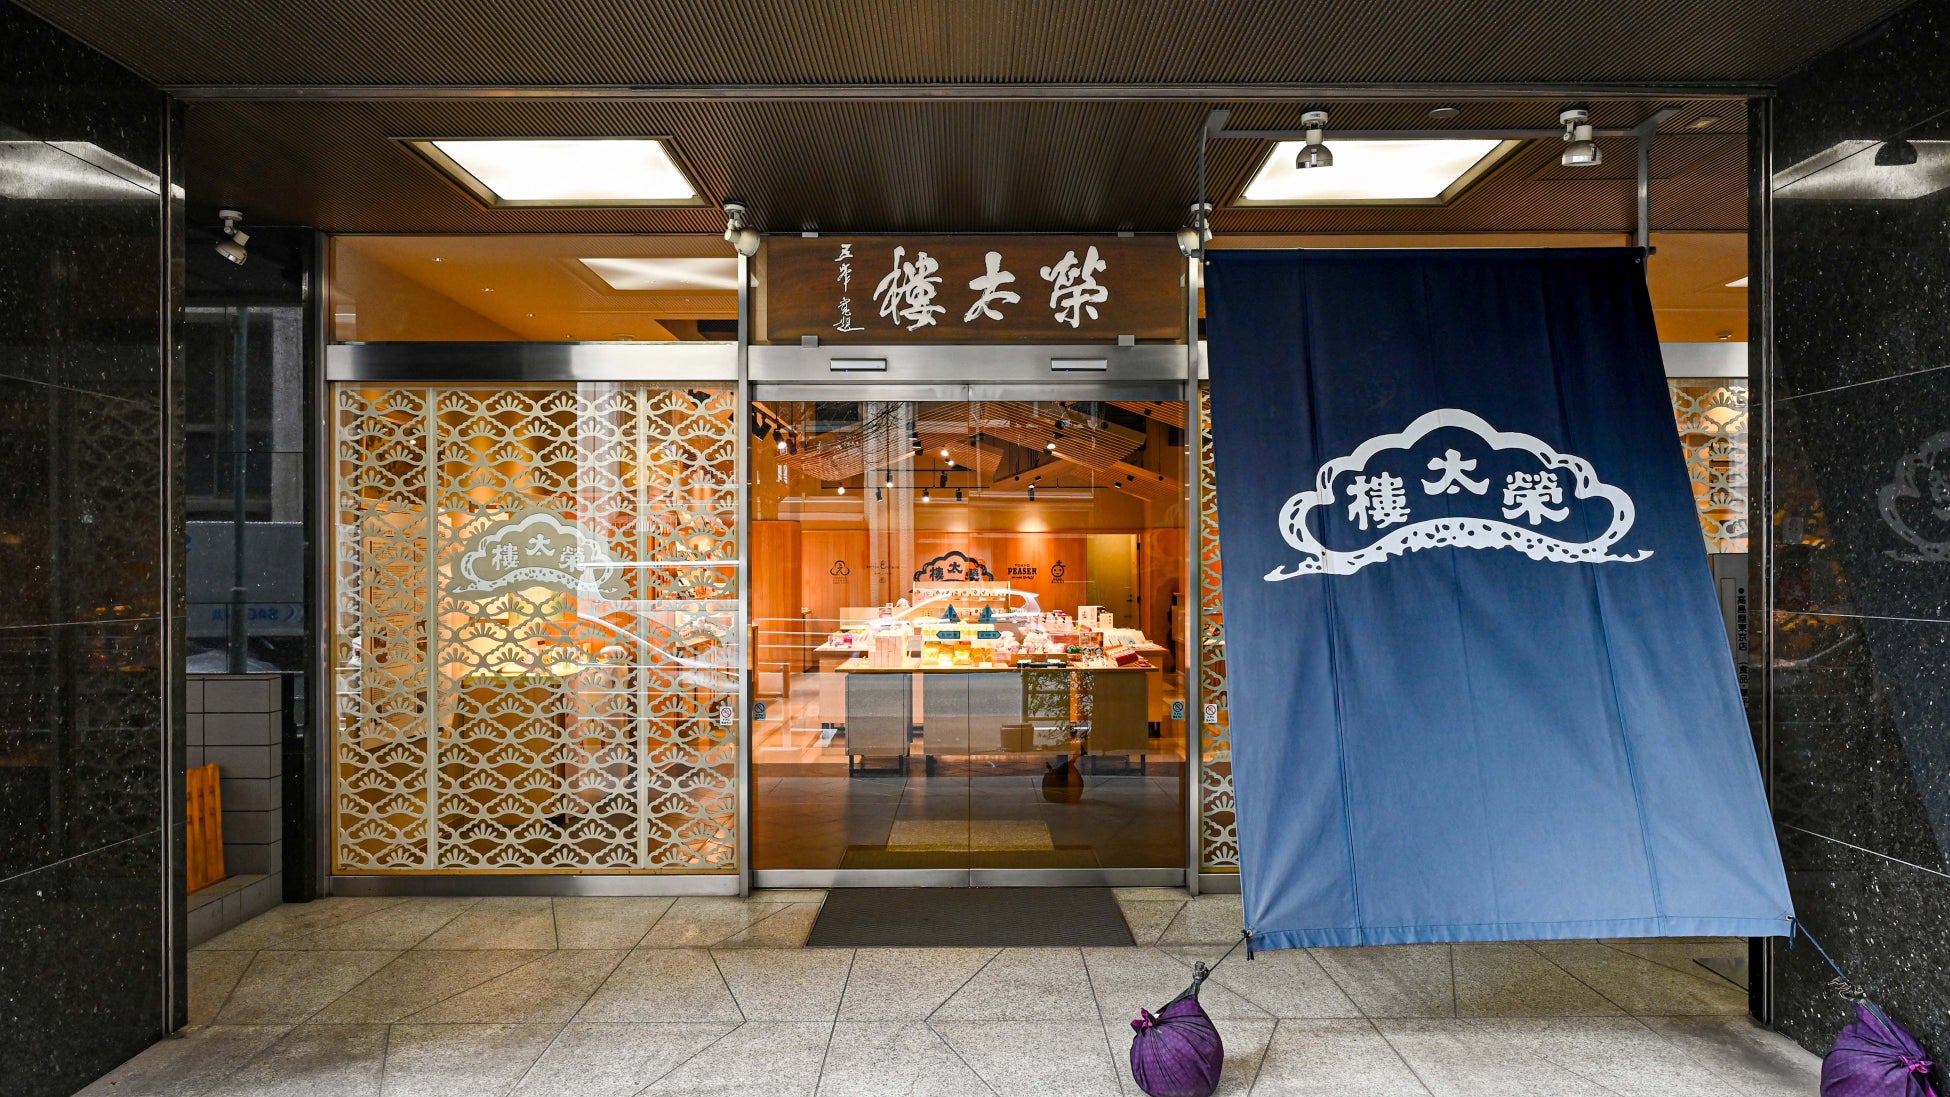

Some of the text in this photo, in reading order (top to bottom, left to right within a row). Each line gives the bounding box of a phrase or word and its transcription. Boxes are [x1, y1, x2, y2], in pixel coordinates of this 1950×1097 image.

[1346, 448, 1570, 531] 榮太樓
[491, 533, 586, 572] 榮太樓
